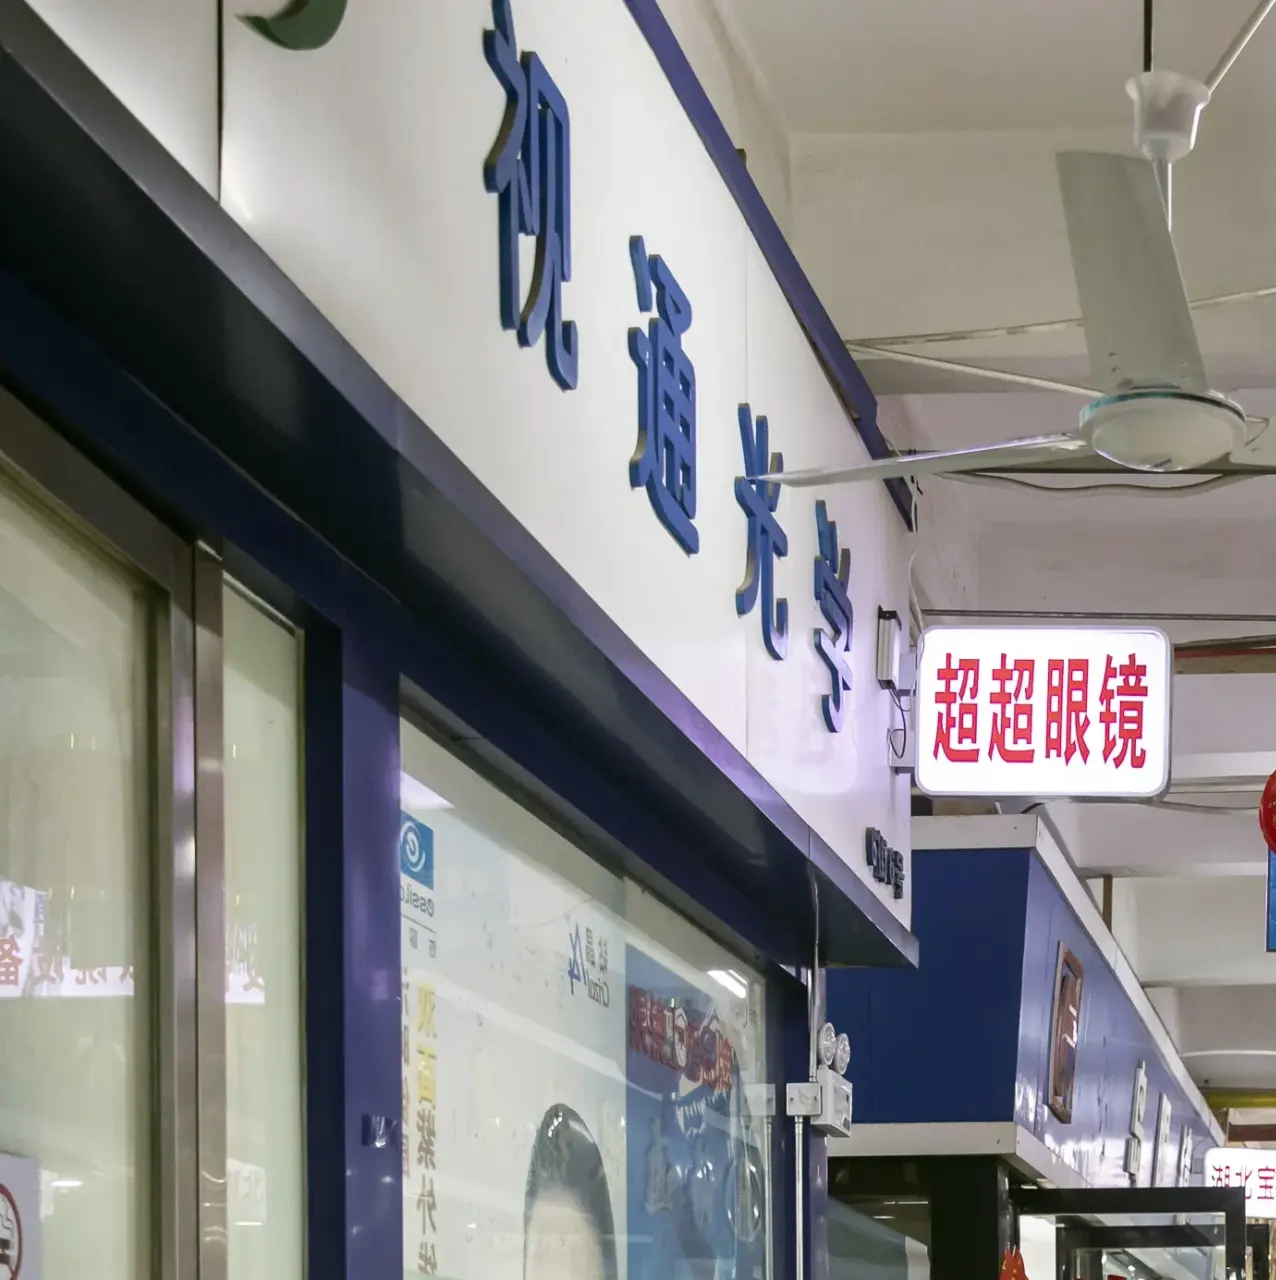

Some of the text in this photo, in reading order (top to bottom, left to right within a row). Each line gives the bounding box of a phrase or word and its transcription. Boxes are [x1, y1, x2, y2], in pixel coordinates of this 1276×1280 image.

[483, 0, 853, 734] 视通光学
[933, 652, 1149, 769] 超超眼镜
